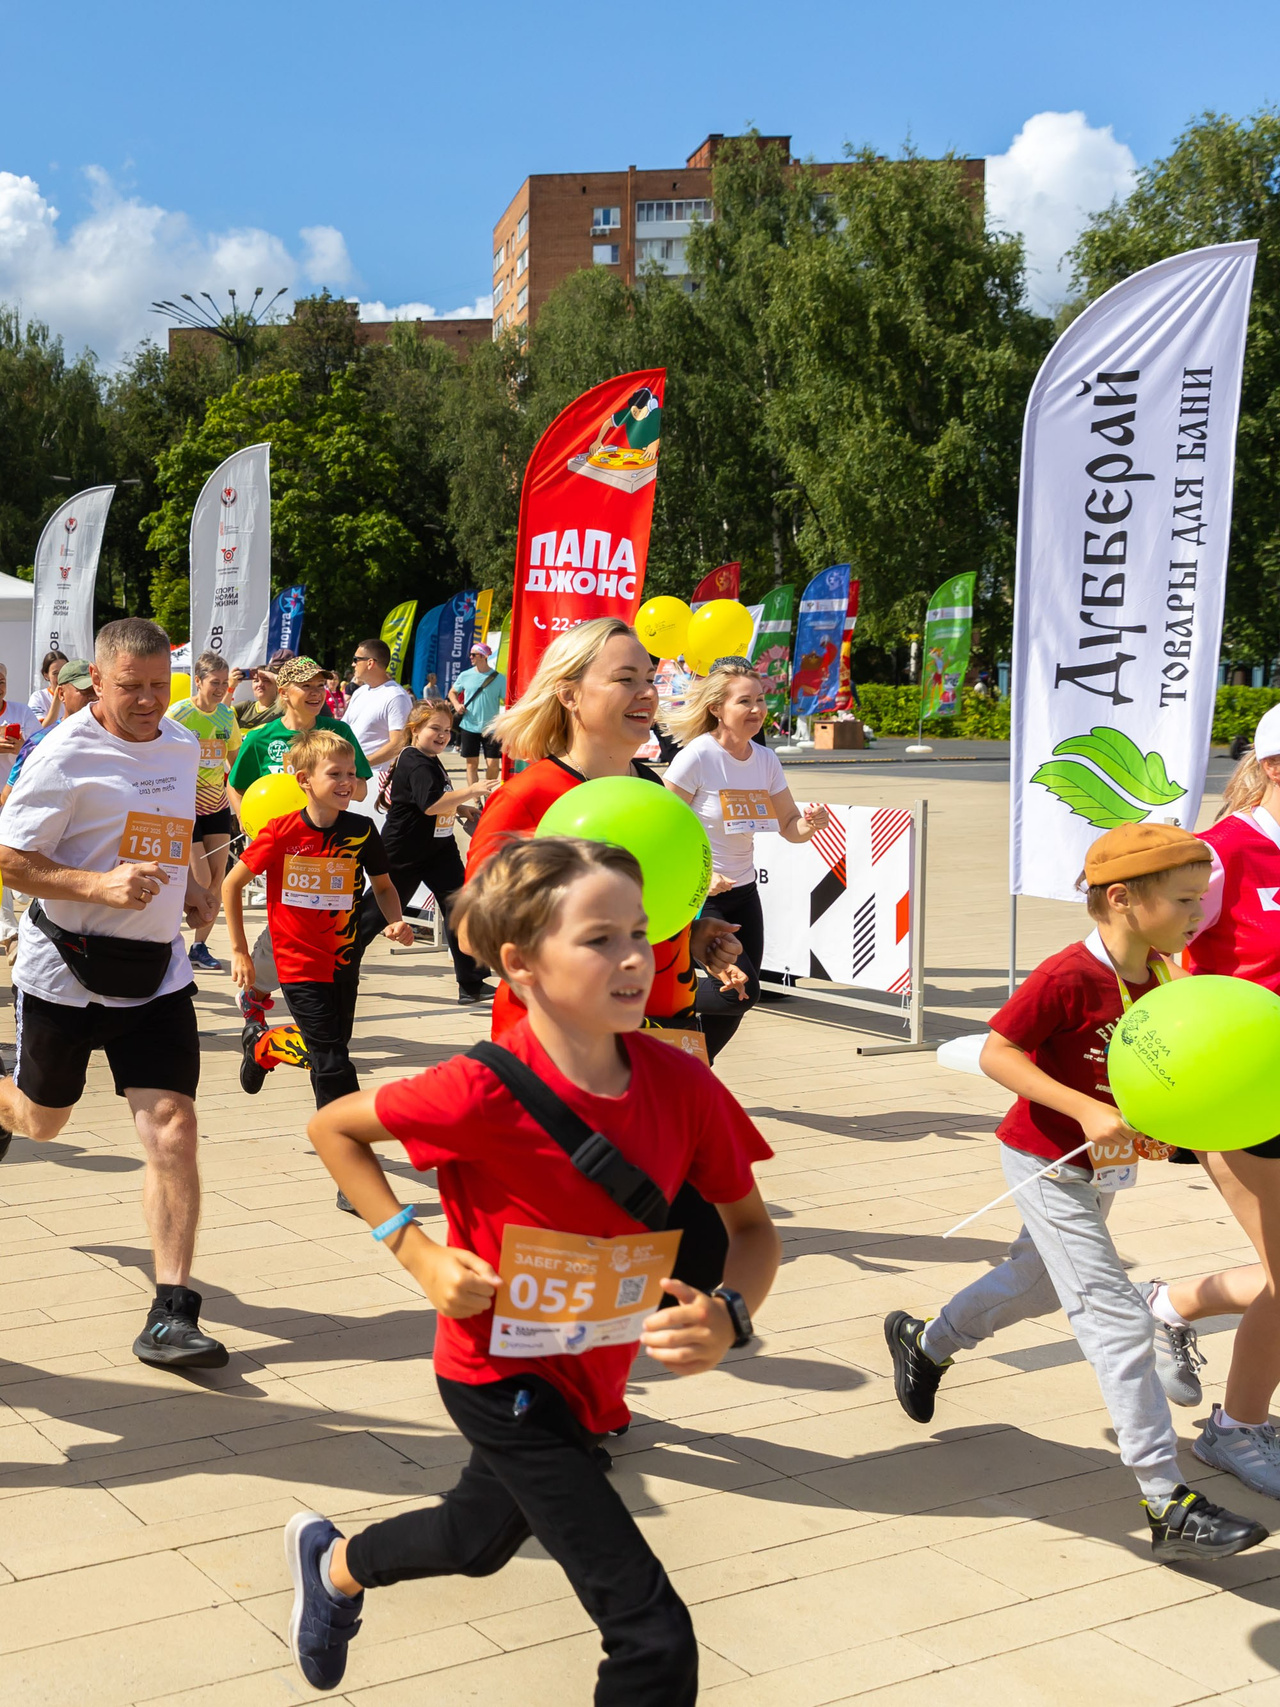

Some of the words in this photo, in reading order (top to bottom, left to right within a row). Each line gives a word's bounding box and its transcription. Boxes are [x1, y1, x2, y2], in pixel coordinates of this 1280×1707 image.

[1176, 366, 1213, 462] БАНИ
[1171, 476, 1208, 546] ДЛЯ
[530, 529, 637, 573] ПАПА
[525, 569, 636, 600] ДЖОНС
[214, 600, 239, 608] ЖИЗНИ
[280, 613, 292, 648] порта
[451, 616, 464, 658] Спорта
[551, 617, 590, 631] 22-
[1159, 559, 1198, 708] ТОВАРЫ
[200, 749, 211, 757] 12
[726, 804, 750, 816] 121
[129, 835, 161, 857] 156
[287, 873, 321, 890] 082
[514, 1253, 563, 1270] ЗАБЕГ
[564, 1261, 598, 1275] 2025
[509, 1273, 596, 1313] 055
